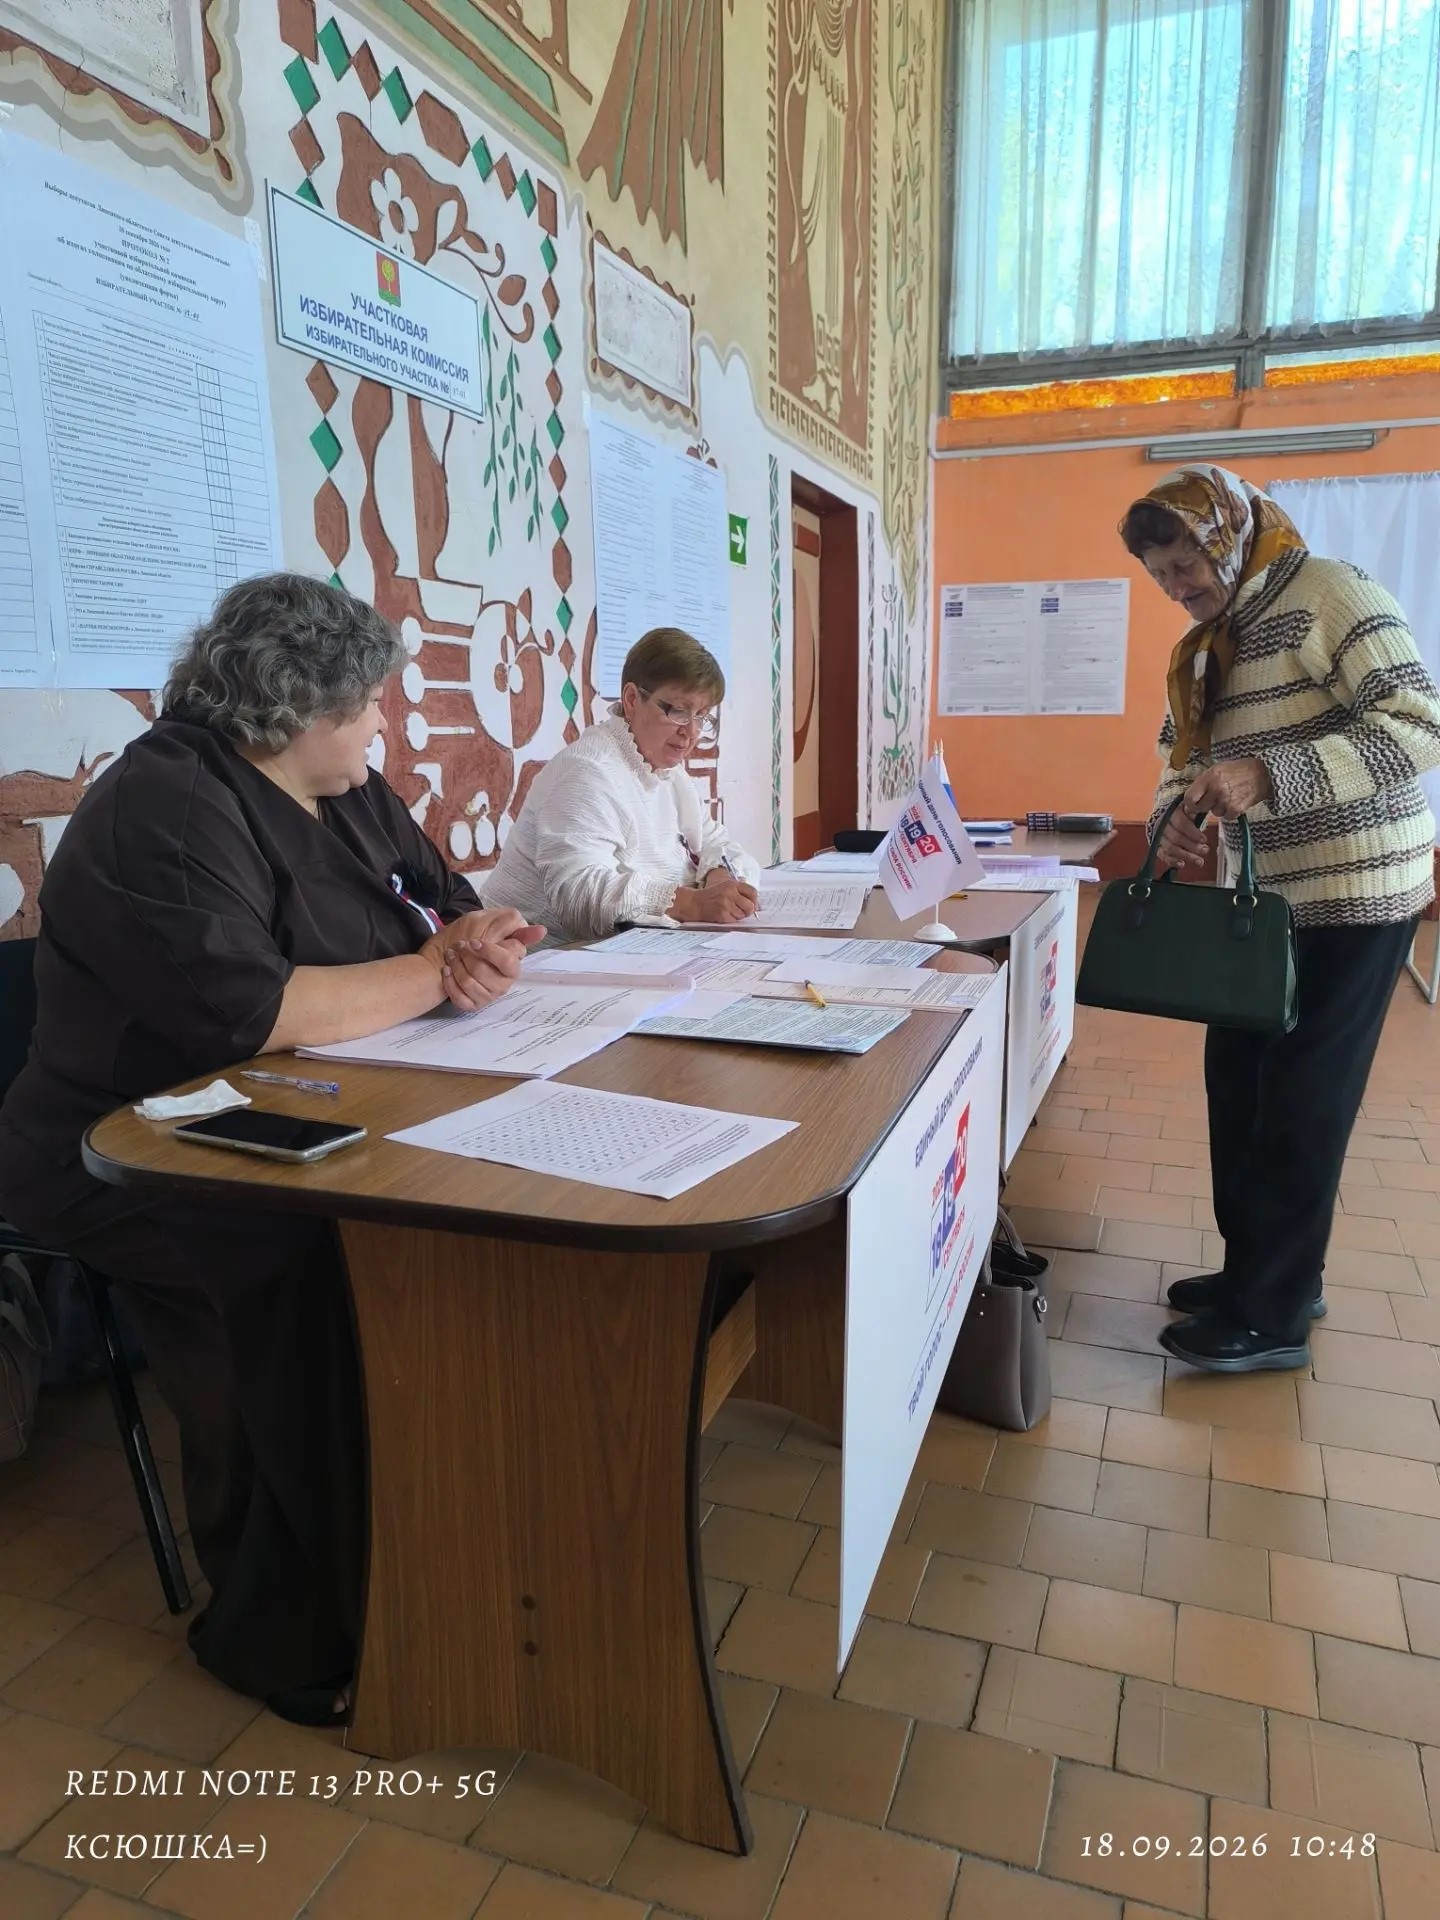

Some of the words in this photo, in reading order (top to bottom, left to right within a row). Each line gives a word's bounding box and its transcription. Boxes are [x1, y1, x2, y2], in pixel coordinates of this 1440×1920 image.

[300, 294, 409, 356] ИЗБИРАТЕЛЬНАЯ
[411, 344, 469, 384] КОМИССИЯ
[350, 292, 428, 344] УЧАСТКОВАЯ
[306, 324, 398, 373] ИЗБИРАТЕЛЬНОГО
[400, 362, 439, 390] УЧАСТКА
[440, 380, 449, 394] №
[900, 814, 909, 828] 18
[908, 824, 922, 839] 19
[920, 836, 936, 854] 20
[911, 804, 920, 820] 2026
[927, 803, 938, 820] ДЕНЬ
[936, 820, 962, 864] ГОЛОСОВАНИЯ
[900, 833, 917, 863] СЕНТЯБРЯ
[915, 1104, 939, 1169] ЕДИНЫЙ
[939, 1088, 953, 1126] ДЕНЬ
[953, 1036, 983, 1096] ГОЛОСОВАНИЯ
[932, 1221, 942, 1278] 18
[955, 1126, 966, 1180] 20
